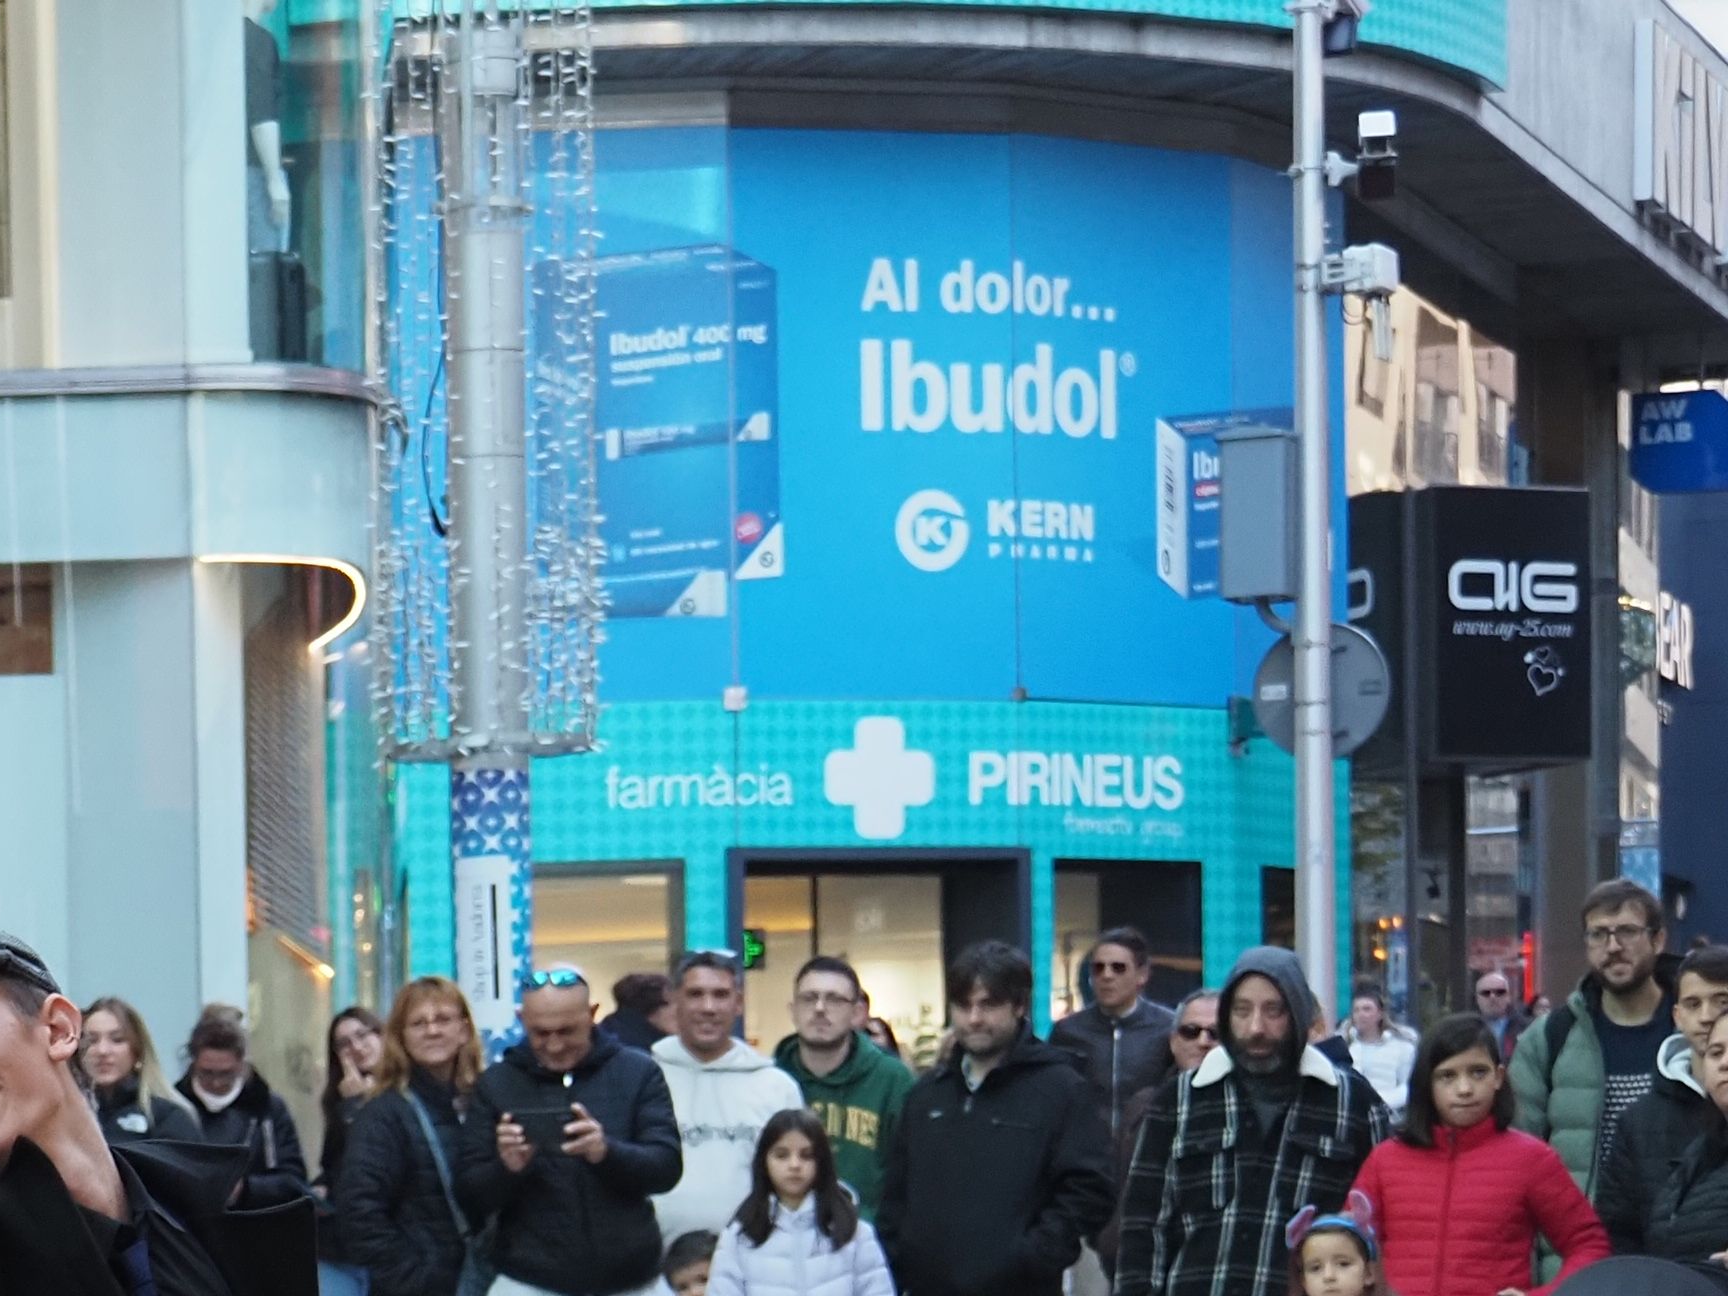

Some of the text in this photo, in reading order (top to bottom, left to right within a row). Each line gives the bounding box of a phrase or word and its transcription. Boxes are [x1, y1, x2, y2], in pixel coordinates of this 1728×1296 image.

[860, 257, 1117, 322] Al dolor...
[737, 323, 768, 345] mg
[1641, 397, 1689, 421] AW
[1639, 422, 1693, 445] LAB
[987, 499, 1095, 542] KERN
[989, 545, 1094, 563] PHARMA
[605, 751, 1184, 811] farmàcia PIRINEUS
